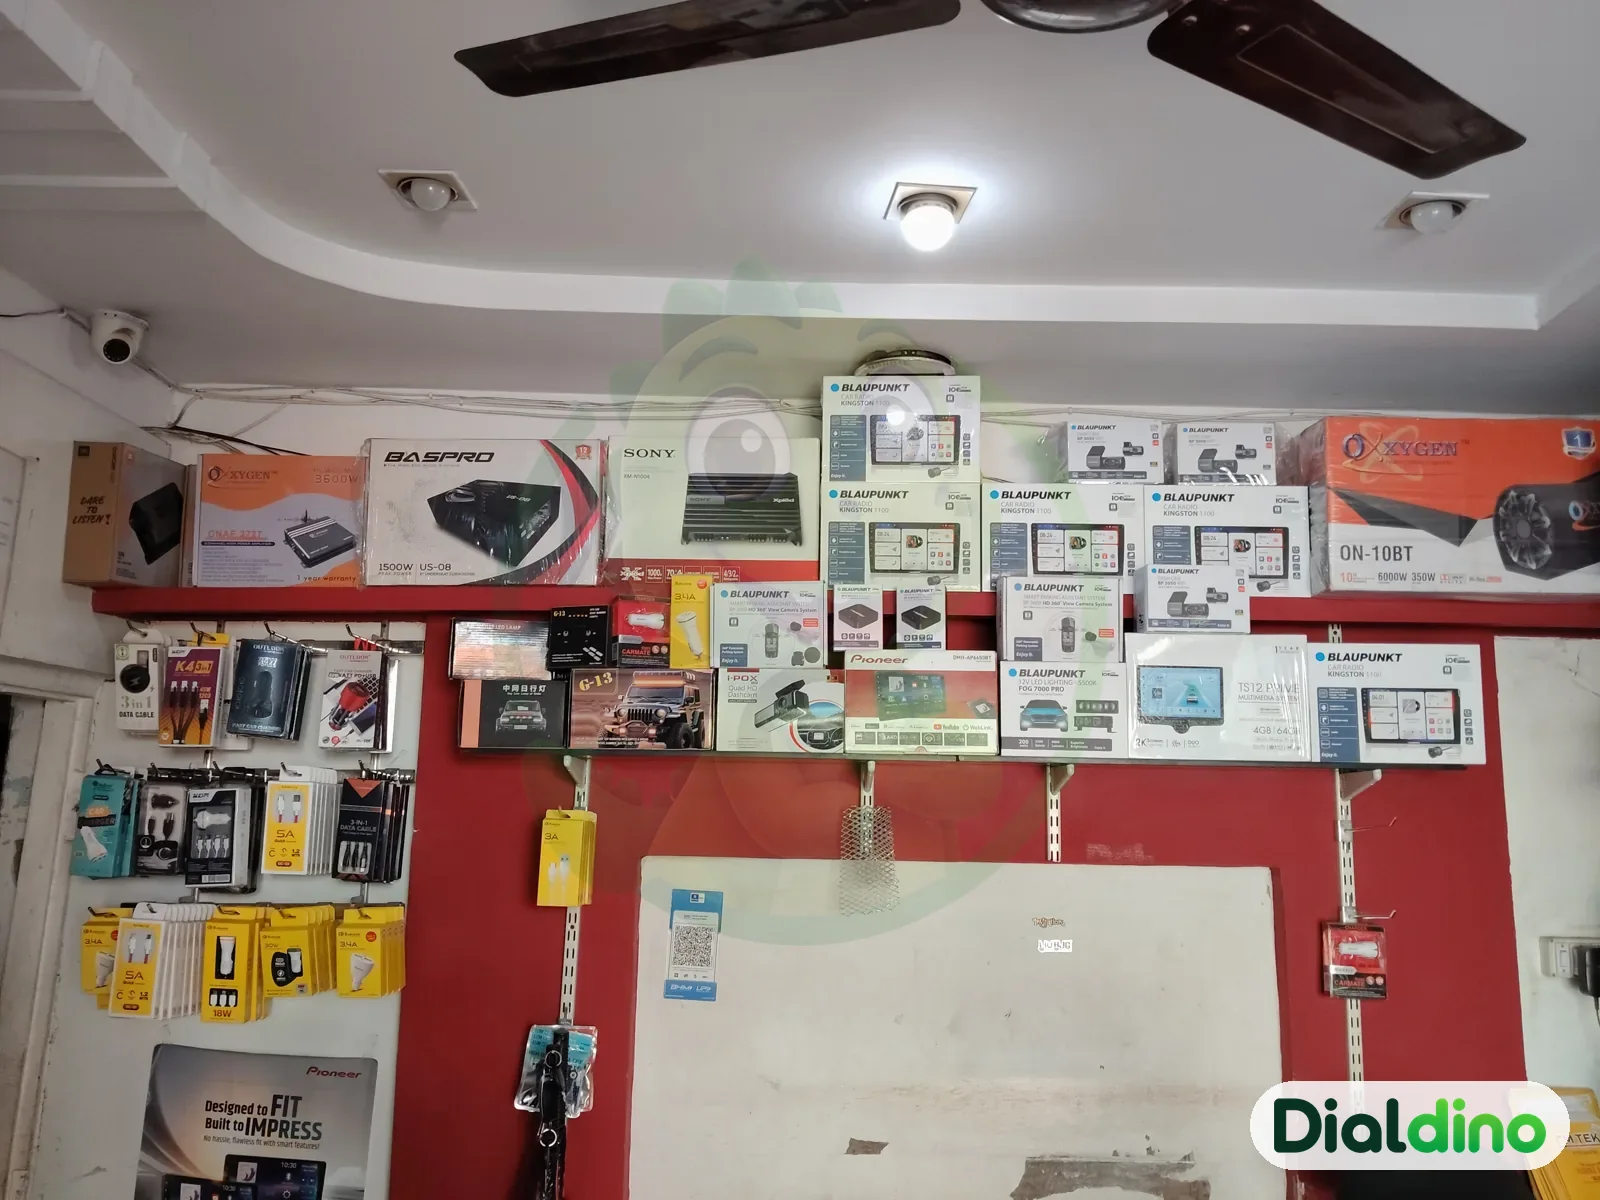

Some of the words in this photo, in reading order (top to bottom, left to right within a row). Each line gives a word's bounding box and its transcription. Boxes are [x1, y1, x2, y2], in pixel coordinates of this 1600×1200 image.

[842, 384, 910, 392] BLAUPUNKT
[384, 452, 495, 463] BASPRO
[624, 448, 675, 458] SONY
[315, 475, 359, 484] 3600W
[840, 491, 909, 499] BLAUPUNKT
[1002, 491, 1072, 500] BLAUPUNKT
[1164, 493, 1236, 502] BLAUPUNKT
[80, 496, 105, 505] DARE
[86, 506, 99, 514] TO
[1340, 545, 1413, 561] ON-10BT
[1340, 572, 1353, 582] 10
[1378, 573, 1407, 581] 6000W
[1411, 573, 1435, 581] 350W
[1024, 584, 1085, 592] BLAUPUNKT
[850, 655, 908, 663] Pioneer
[1328, 653, 1403, 662] BLAUPUNKT
[175, 660, 195, 672] K4
[1018, 669, 1086, 678] BLAUPUNKT
[579, 672, 613, 691] G-13
[1238, 683, 1263, 692] TS12
[1266, 683, 1300, 693] PRIME
[121, 696, 130, 708] 3
[132, 700, 143, 708] in
[147, 696, 151, 708] 1
[276, 830, 295, 838] 5A
[125, 971, 144, 980] 5A
[213, 1010, 232, 1018] 18W
[306, 1066, 362, 1079] Pioneer
[205, 1100, 254, 1116] Designed
[257, 1104, 268, 1116] to
[270, 1094, 303, 1118] FIT
[205, 1117, 230, 1131] Built
[233, 1120, 244, 1131] to
[244, 1117, 323, 1141] IMPRESS
[1575, 1133, 1600, 1144] TEK
[232, 1137, 255, 1146] flawless
[276, 1141, 293, 1149] smart
[294, 1141, 320, 1150] features!
